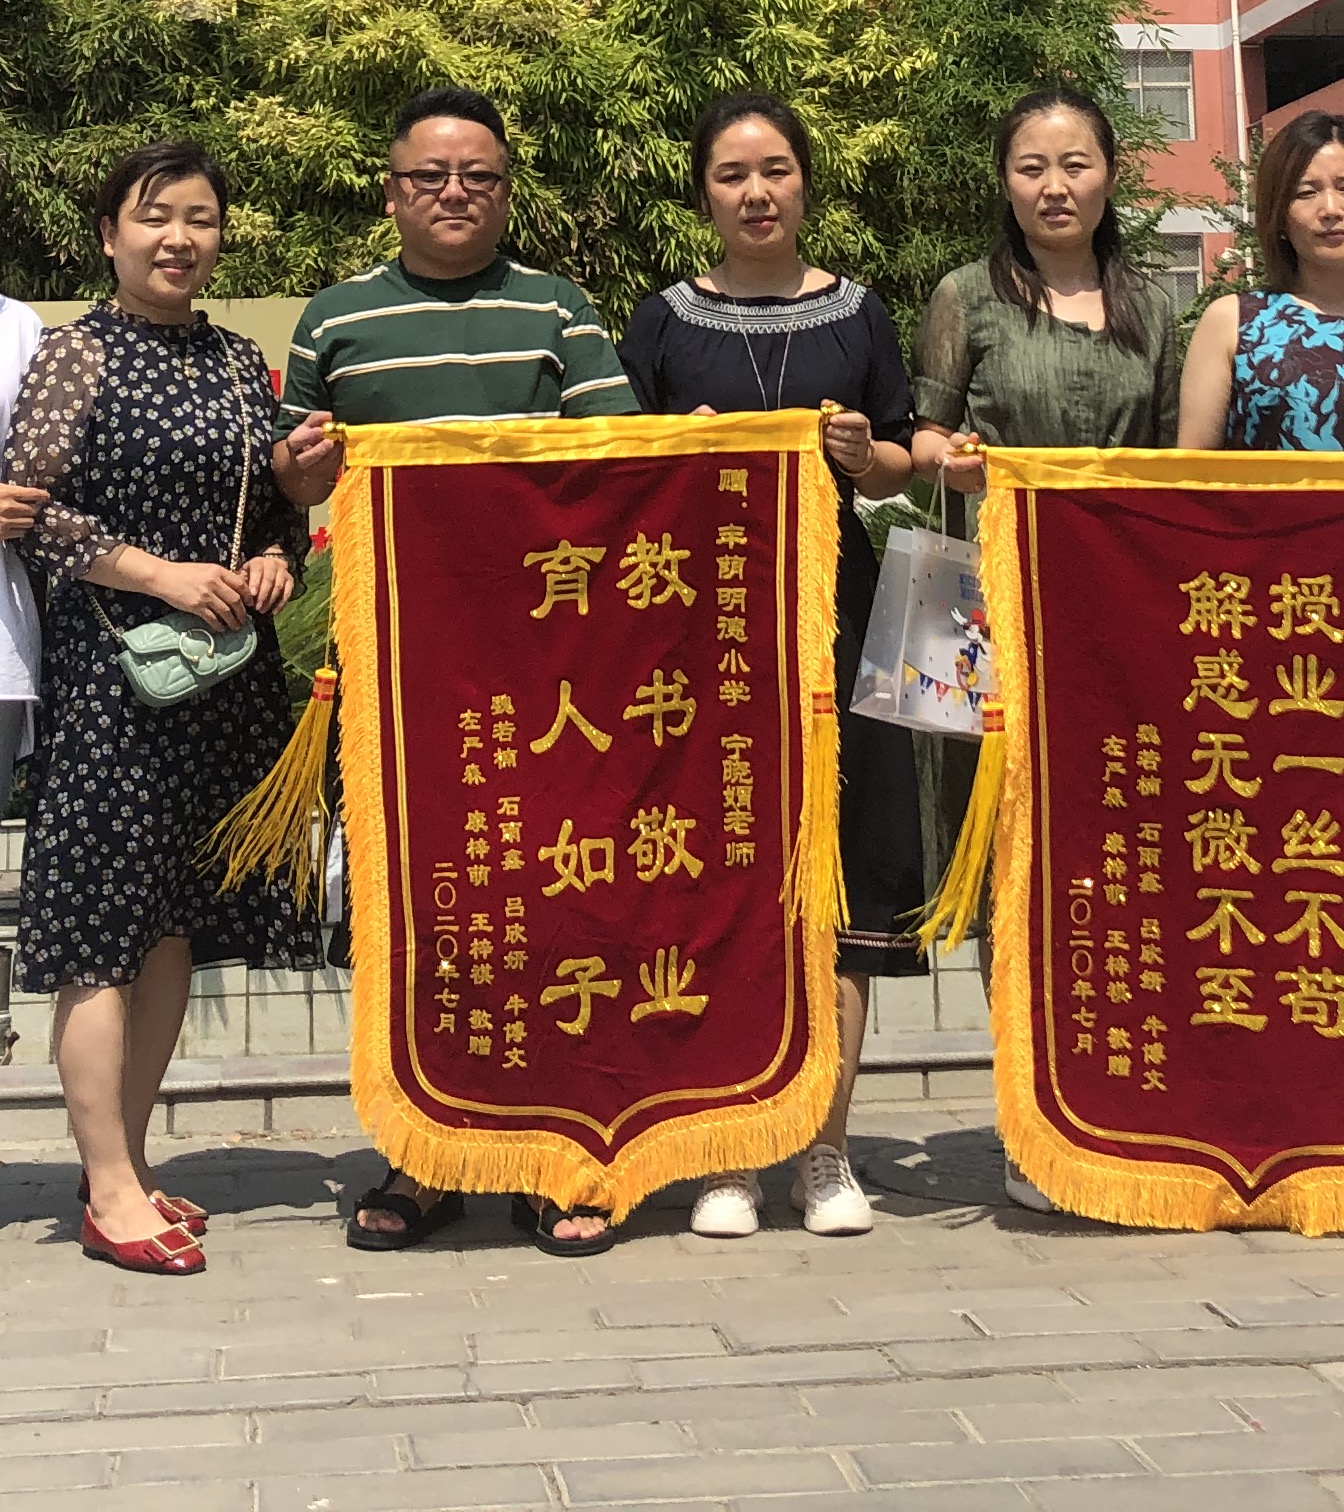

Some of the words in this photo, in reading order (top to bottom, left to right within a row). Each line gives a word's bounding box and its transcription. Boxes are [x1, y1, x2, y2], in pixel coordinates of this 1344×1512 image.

[523, 540, 622, 1035] 育人如子
[616, 531, 709, 1022] 教书敬业
[721, 734, 755, 866] 宁晓娟老师
[1179, 571, 1268, 1031] 解惑无微不至
[468, 1009, 493, 1055] 敬赠
[502, 994, 528, 1069] 牛博文
[1106, 1027, 1133, 1076] 敬赠
